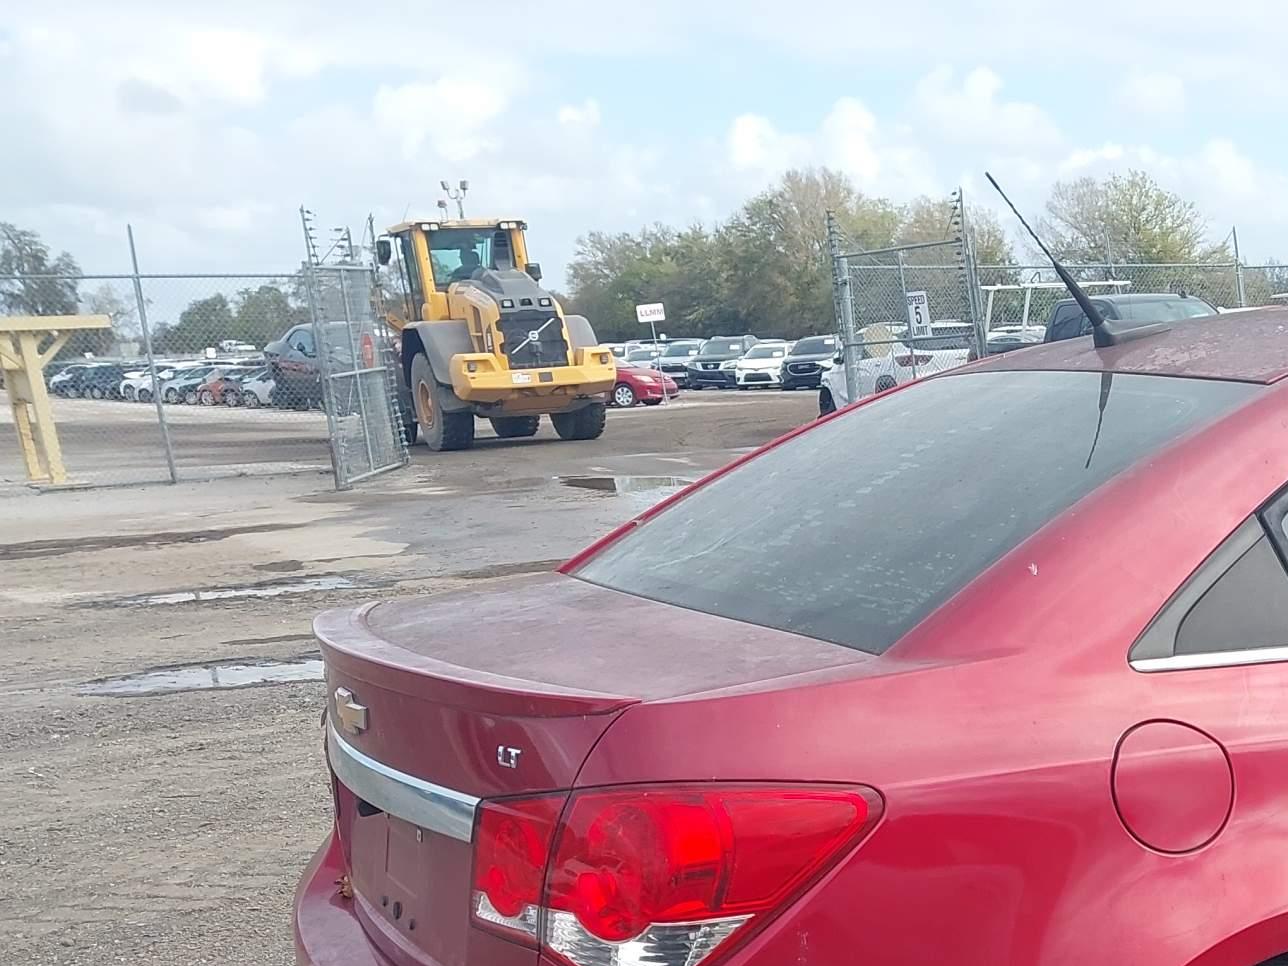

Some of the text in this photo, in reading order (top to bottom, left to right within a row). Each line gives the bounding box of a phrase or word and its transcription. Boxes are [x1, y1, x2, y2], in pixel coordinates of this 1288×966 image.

[907, 295, 925, 306] SPEED
[914, 306, 923, 324] 5
[912, 325, 929, 337] LIMIT
[497, 745, 521, 769] LT
